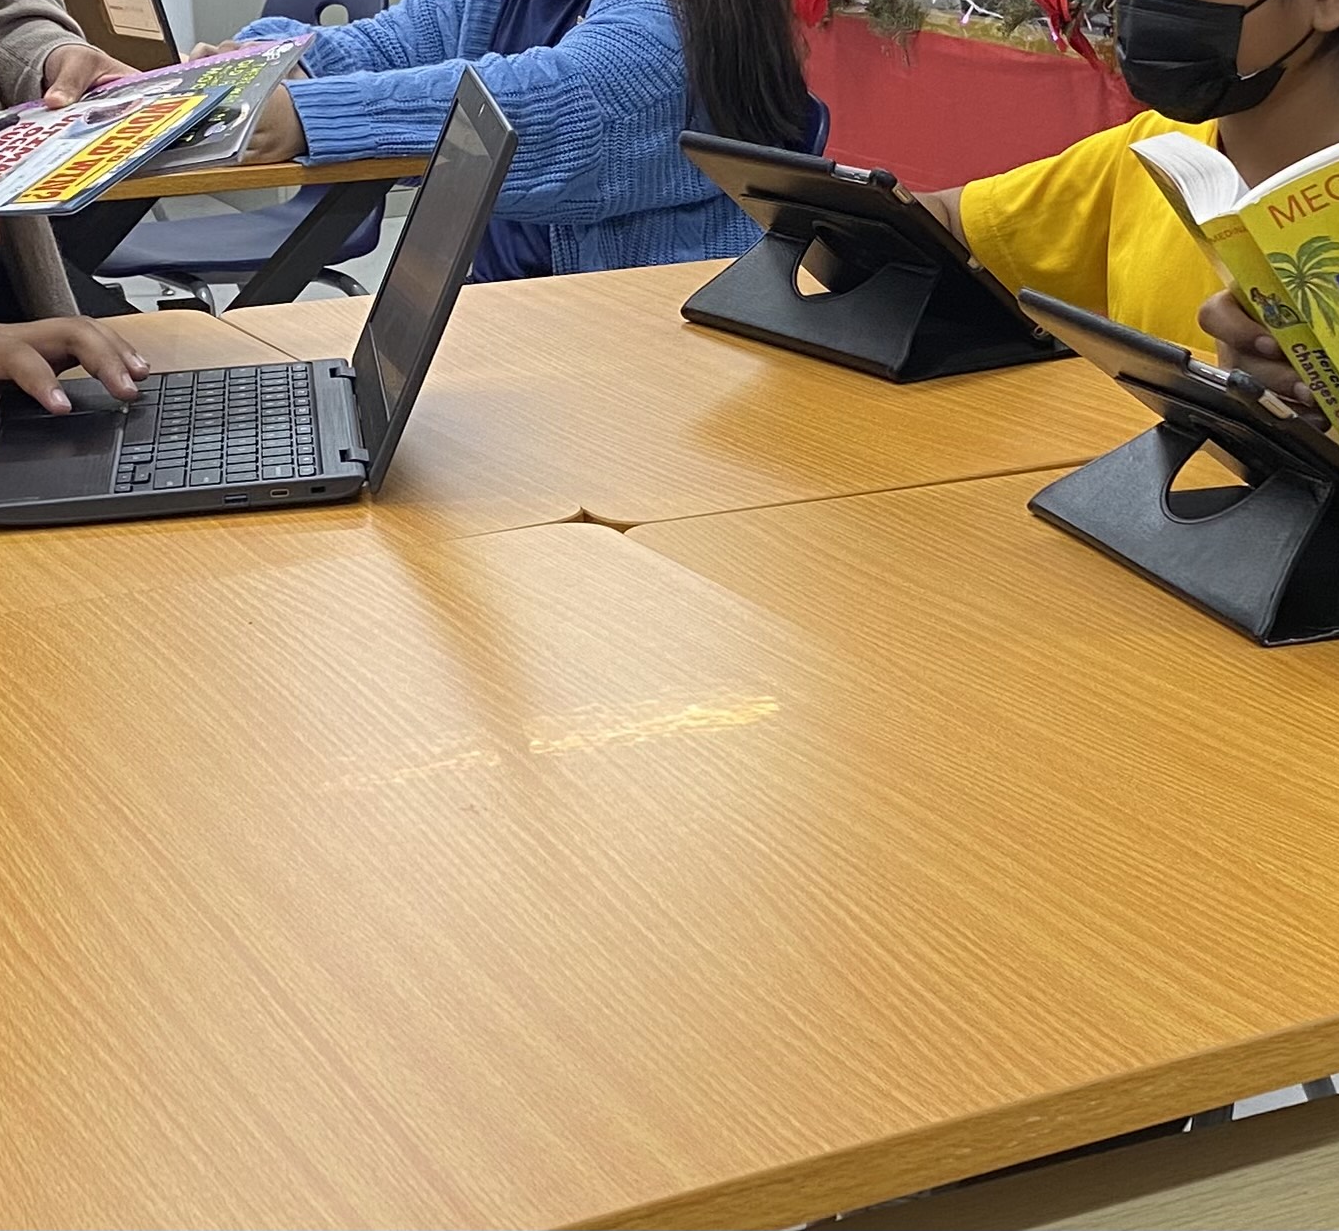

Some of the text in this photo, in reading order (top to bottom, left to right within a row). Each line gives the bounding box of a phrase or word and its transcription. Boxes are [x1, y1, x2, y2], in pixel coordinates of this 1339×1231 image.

[23, 97, 192, 201] WOULD WIN?
[1291, 342, 1339, 407] Changes
